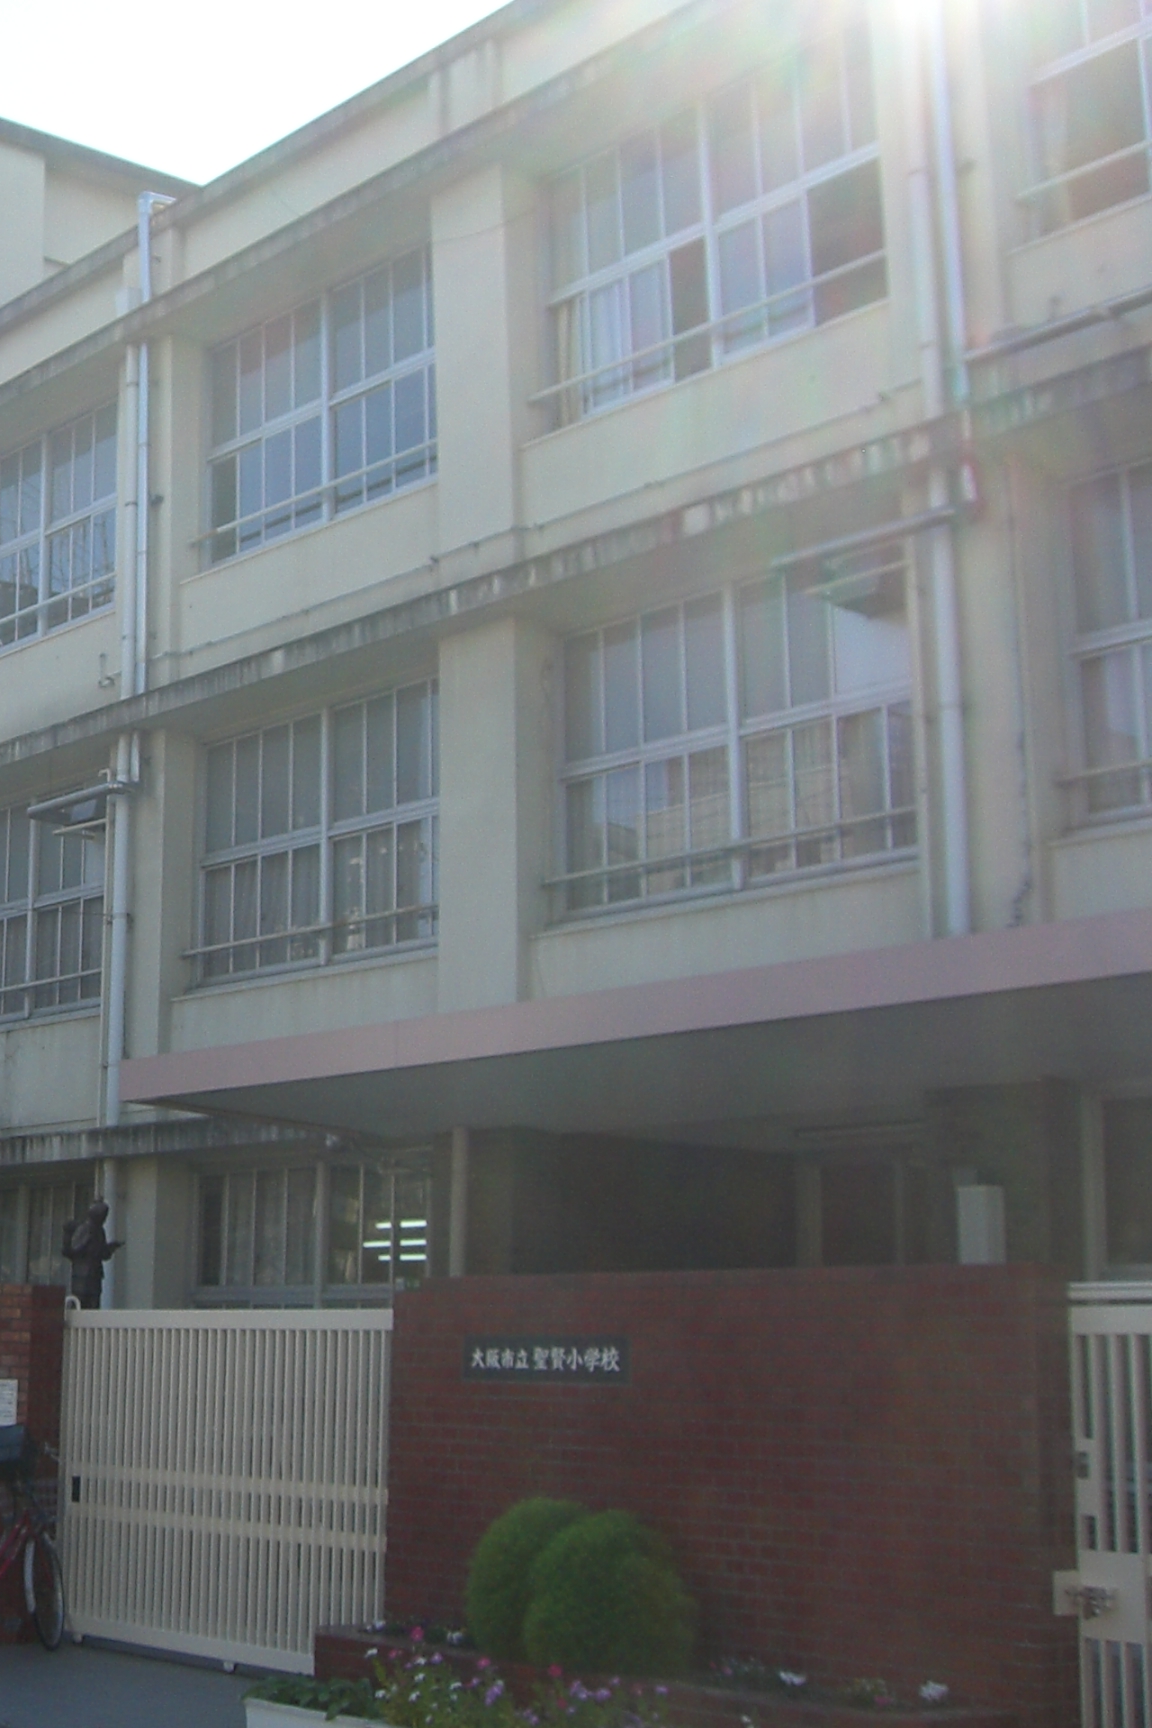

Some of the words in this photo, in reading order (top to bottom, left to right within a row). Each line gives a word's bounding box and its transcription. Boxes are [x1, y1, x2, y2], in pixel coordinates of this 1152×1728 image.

[471, 1346, 620, 1372] 大阪市立聖賢小学校
